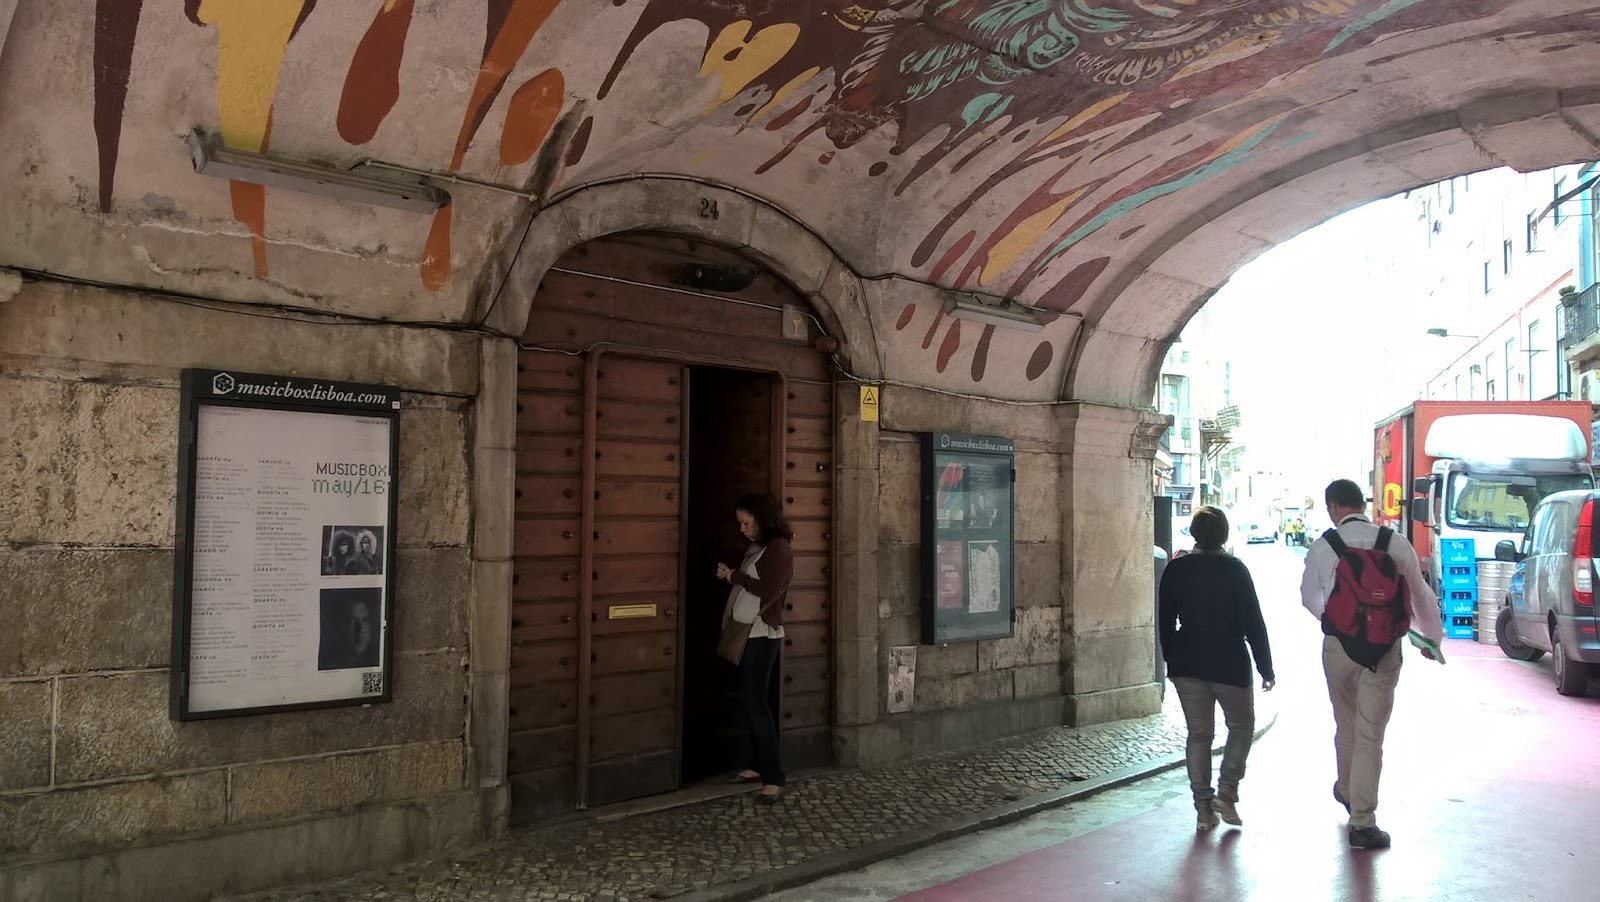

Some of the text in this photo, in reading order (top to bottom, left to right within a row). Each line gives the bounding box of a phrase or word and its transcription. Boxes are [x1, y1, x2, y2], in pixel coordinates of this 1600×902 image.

[700, 198, 720, 221] 24
[237, 381, 387, 405] musicboxlisboa.com
[316, 461, 387, 477] MUSICBOX
[311, 477, 386, 498] may/16
